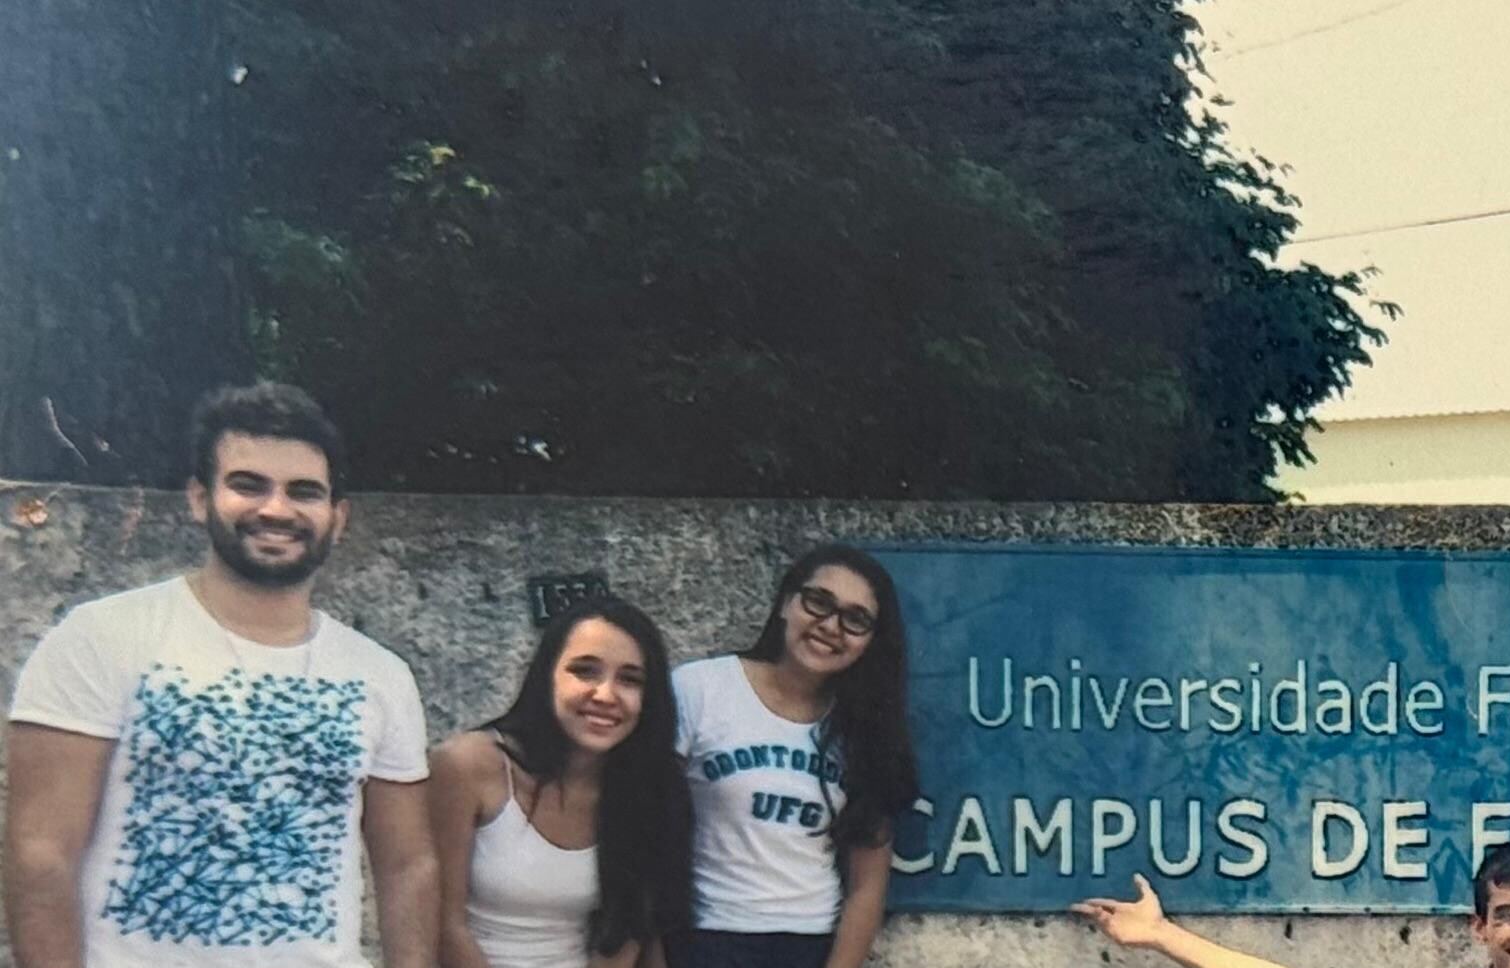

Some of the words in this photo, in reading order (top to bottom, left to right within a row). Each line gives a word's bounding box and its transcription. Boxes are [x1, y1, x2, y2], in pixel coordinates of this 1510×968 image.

[968, 656, 1444, 735] Universidade
[751, 791, 825, 828] UFG
[890, 797, 1268, 878] CAMPUS
[1311, 800, 1429, 879] DE
